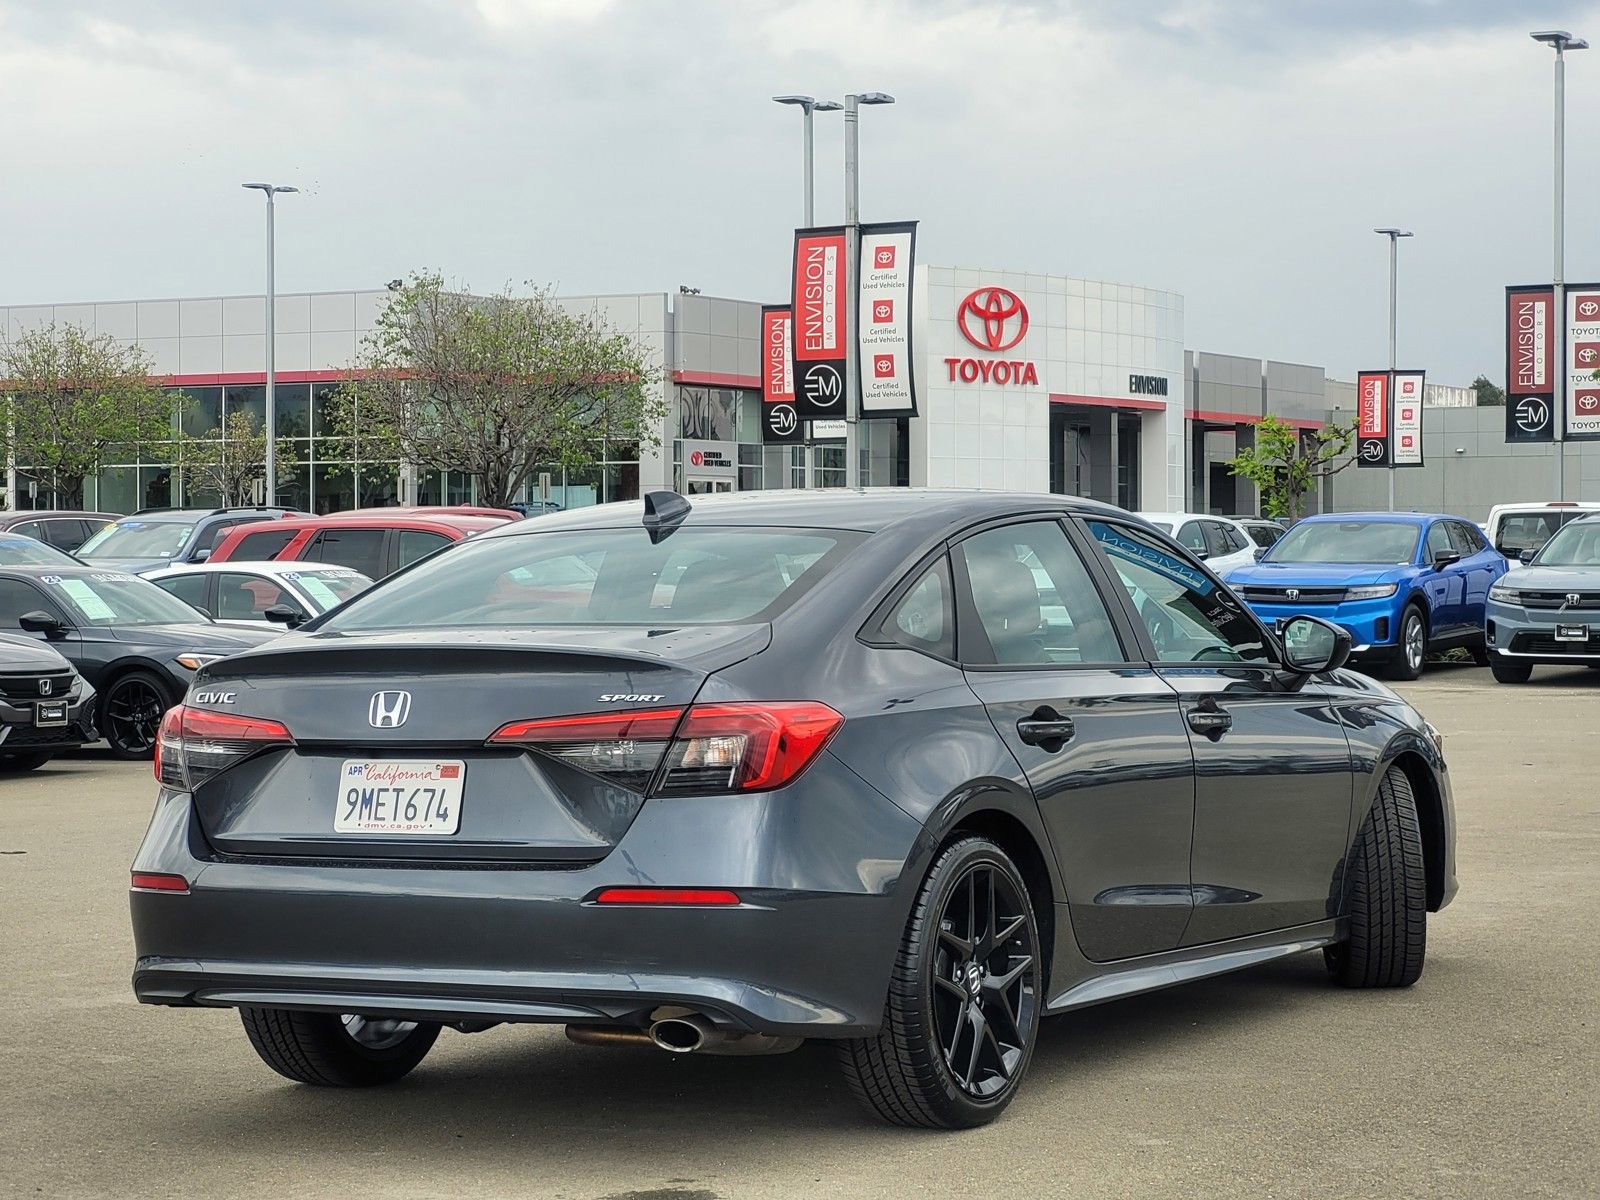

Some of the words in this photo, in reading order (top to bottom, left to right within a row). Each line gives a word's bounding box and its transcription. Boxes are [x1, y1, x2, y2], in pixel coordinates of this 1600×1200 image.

[870, 273, 898, 281] Certified
[805, 246, 824, 351] ENVISION
[826, 255, 834, 341] MOTORS
[1518, 301, 1534, 386] ENVISION
[771, 319, 784, 395] ENVISION
[943, 358, 1039, 386] TOYOTA
[872, 382, 899, 390] Certified
[1129, 375, 1168, 396] ENVISION
[1364, 380, 1375, 433] ENVISION
[195, 692, 237, 704] CIVIC
[597, 694, 666, 702] SPORT
[347, 766, 363, 776] APR
[365, 764, 440, 786] California
[343, 787, 449, 822] 9MET674
[364, 822, 426, 830] dmv.ca.gov
